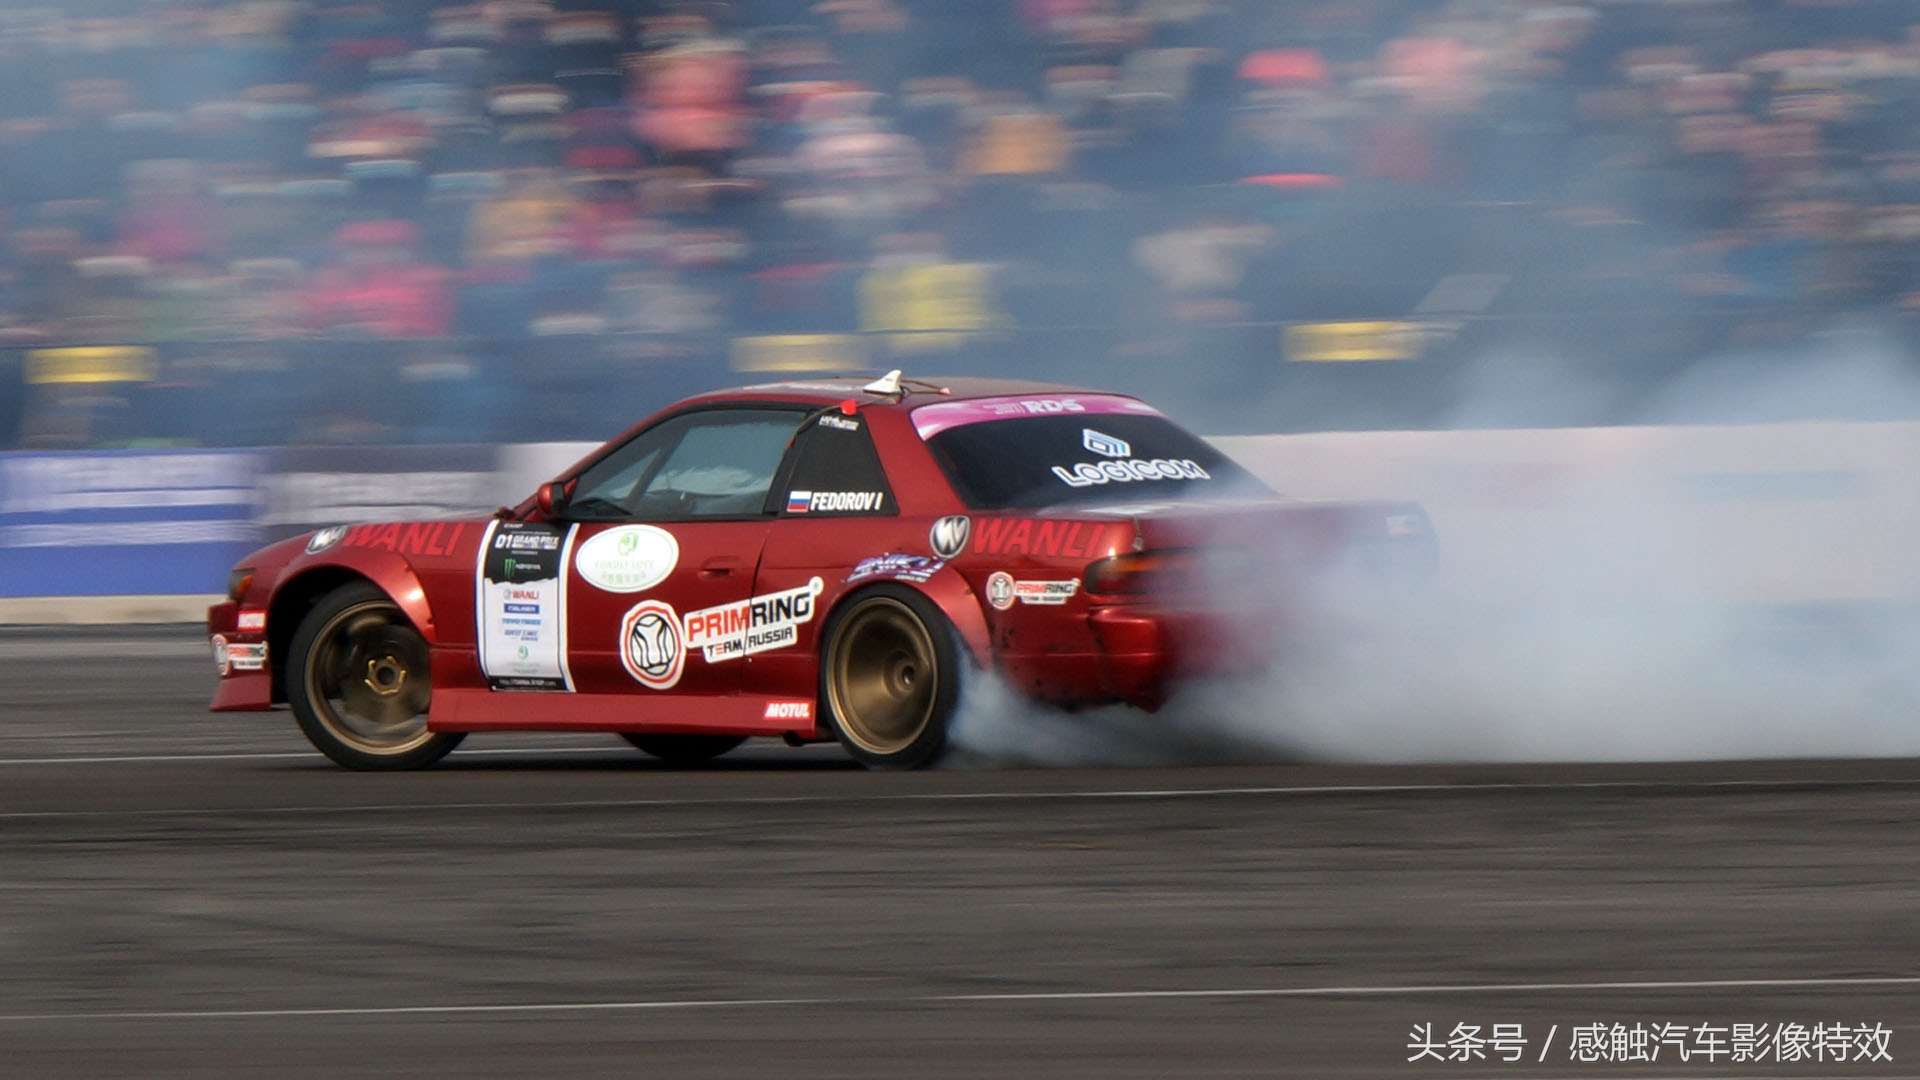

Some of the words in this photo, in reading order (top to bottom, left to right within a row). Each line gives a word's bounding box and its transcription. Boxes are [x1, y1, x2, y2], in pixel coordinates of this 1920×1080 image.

[1020, 399, 1085, 413] RDS
[1051, 459, 1211, 487] LOGICOM
[810, 492, 875, 511] FEDOROV
[874, 492, 884, 511] I
[342, 522, 465, 556] WANLI
[494, 534, 513, 549] D1
[973, 518, 1104, 558] WANLI
[512, 590, 539, 599] WANLI
[1017, 583, 1073, 594] PRIMRING
[688, 591, 811, 643] PRIMRING
[707, 638, 743, 657] TEAM
[748, 626, 793, 648] RUSSIA
[765, 703, 809, 717] MOTUL
